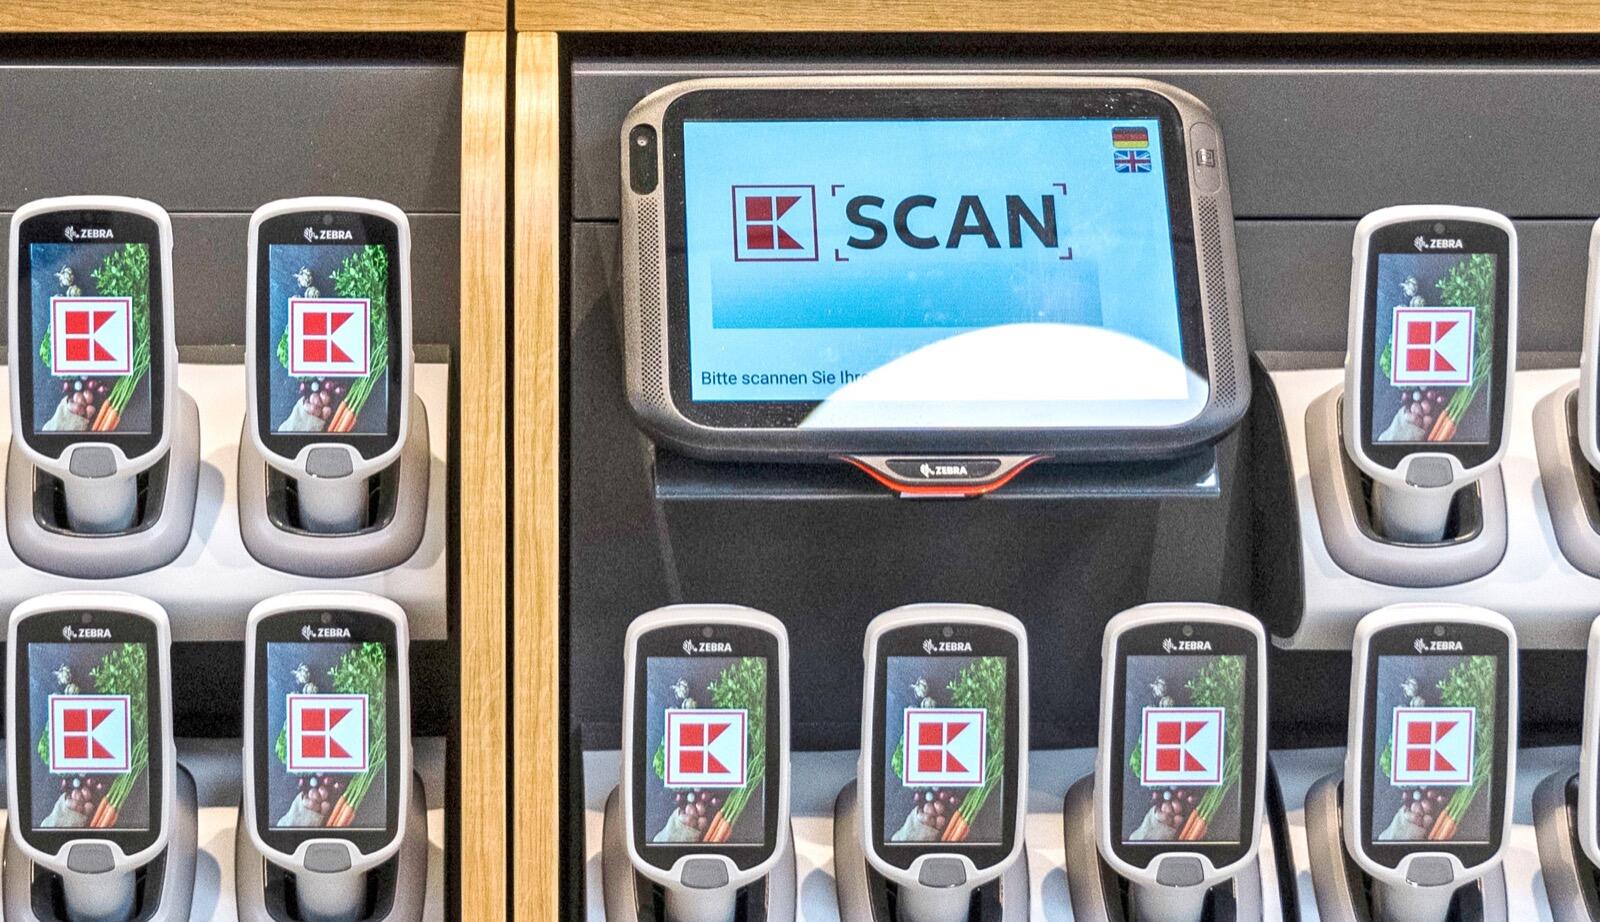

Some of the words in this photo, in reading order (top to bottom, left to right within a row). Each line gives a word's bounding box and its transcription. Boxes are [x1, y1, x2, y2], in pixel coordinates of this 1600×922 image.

[845, 194, 1059, 250] SCAN
[80, 228, 114, 239] ZEBRA
[319, 229, 353, 240] ZEBRA
[1428, 238, 1464, 249] ZEBRA
[701, 371, 738, 386] Bitte
[741, 372, 808, 386] scannen
[812, 370, 836, 385] Sie
[934, 465, 968, 476] ZEBRA
[78, 628, 112, 639] ZEBRA
[317, 627, 351, 638] ZEBRA
[698, 642, 733, 653] ZEBRA
[938, 641, 973, 652] ZEBRA
[1178, 640, 1212, 651] ZEBRA
[1428, 640, 1464, 651] ZEBRA
